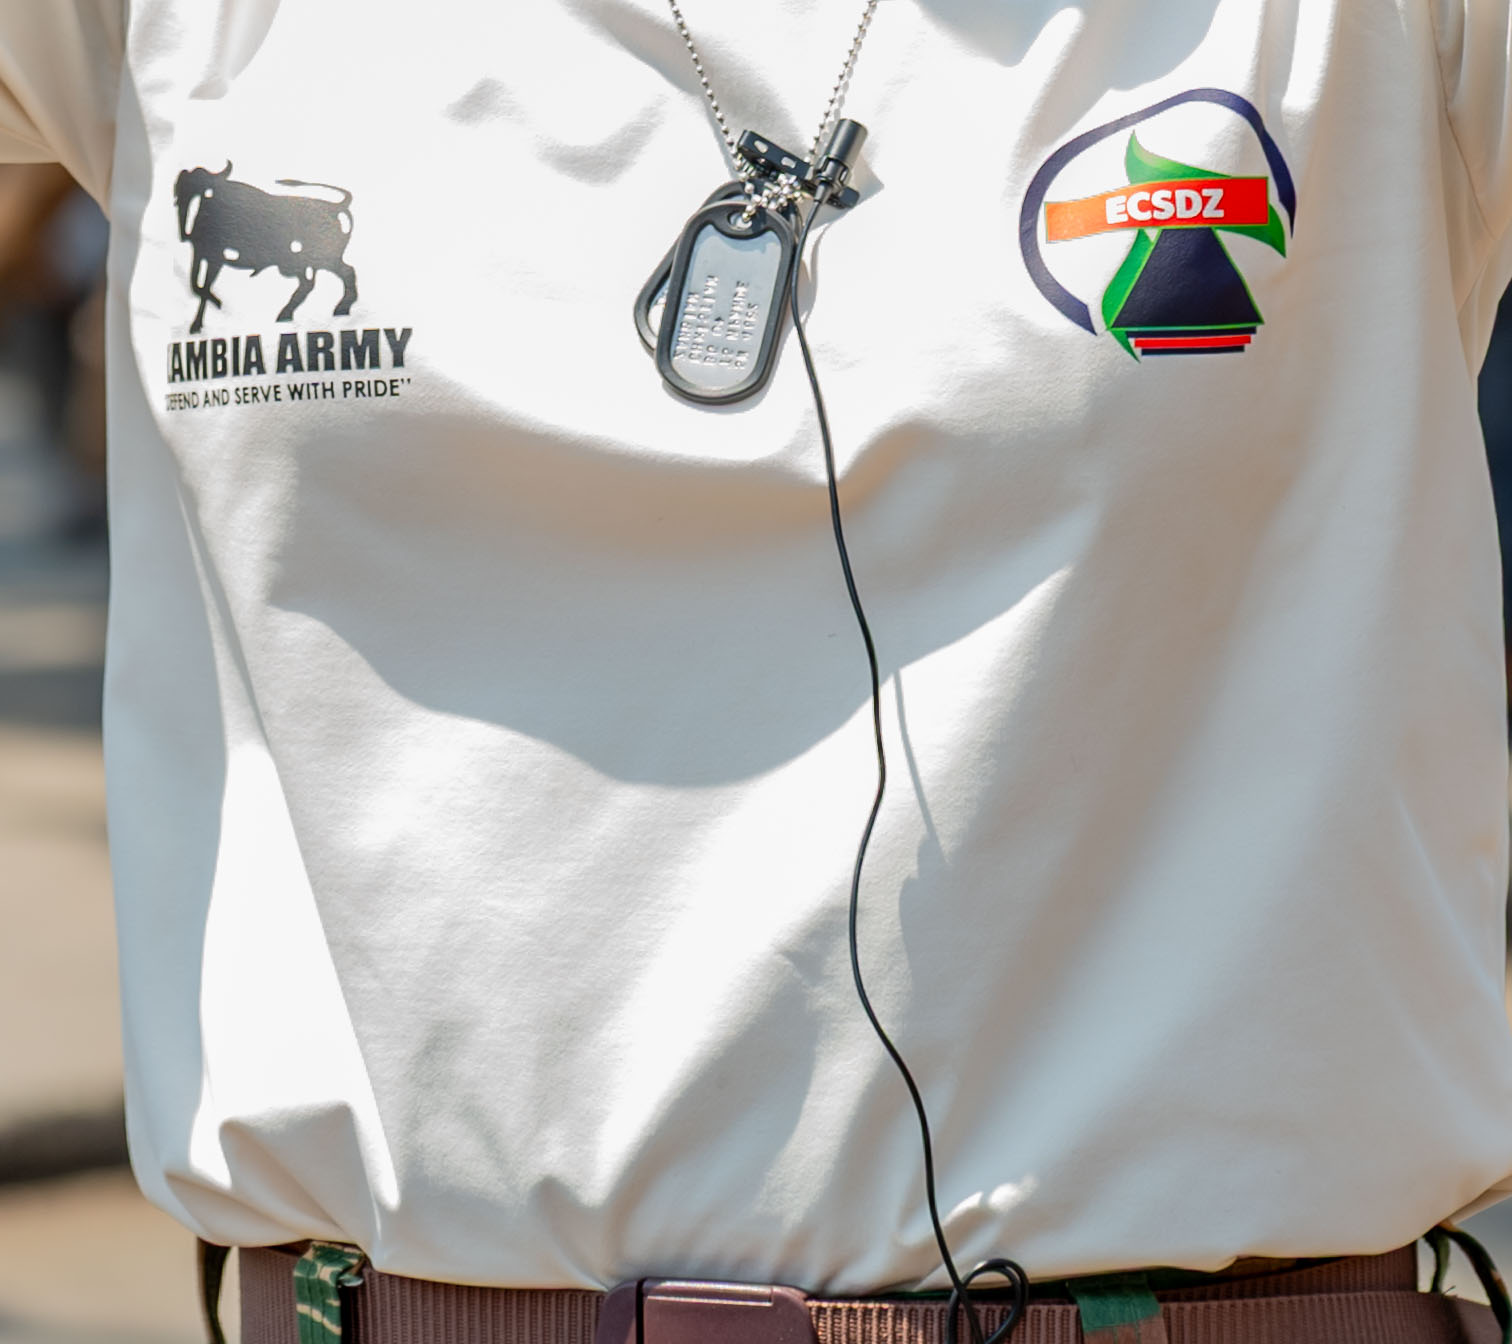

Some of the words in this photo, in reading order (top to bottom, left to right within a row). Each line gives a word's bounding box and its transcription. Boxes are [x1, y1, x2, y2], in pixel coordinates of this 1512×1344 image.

[1105, 188, 1224, 224] ECSDZ
[167, 334, 266, 383] AMBIA
[276, 328, 413, 374] ARMY
[203, 389, 230, 407] AND
[235, 384, 282, 405] SERVE
[287, 382, 335, 401] WITH
